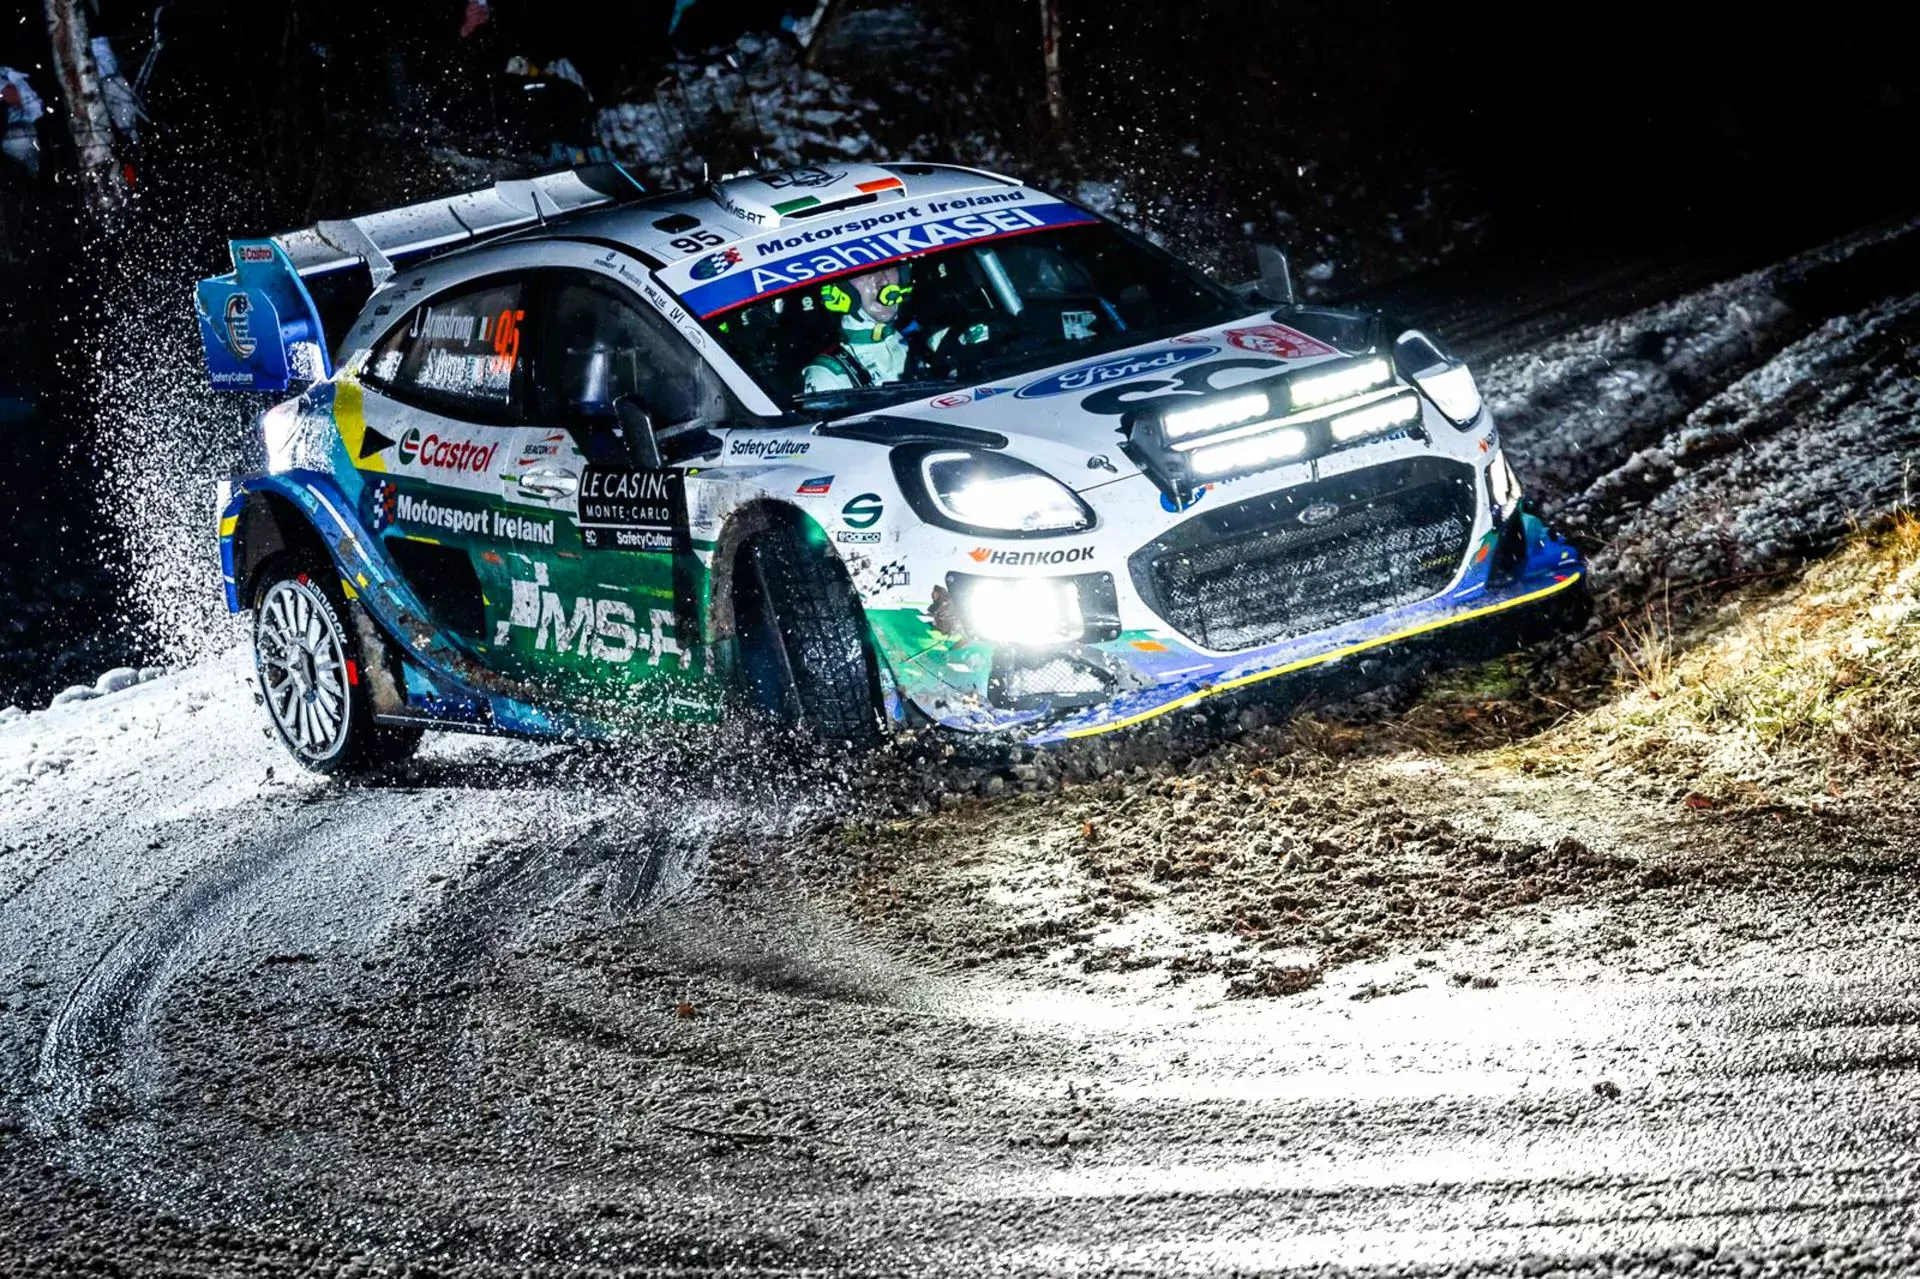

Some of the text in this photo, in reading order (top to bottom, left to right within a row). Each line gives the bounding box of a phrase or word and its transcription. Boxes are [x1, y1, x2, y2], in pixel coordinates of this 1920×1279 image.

[726, 205, 766, 225] MS-RT
[756, 190, 1024, 256] Motorsport Ireland
[670, 231, 725, 254] 95
[752, 208, 1046, 293] AsahiKASEI
[409, 307, 421, 338] J
[421, 307, 475, 348] Armstrong
[1058, 352, 1187, 390] Ford
[420, 434, 500, 472] Castrol
[730, 439, 810, 458] SafetyCulture
[581, 471, 600, 497] LE
[397, 494, 554, 545] Motorsport Ireland
[616, 531, 673, 549] SafetyCultur
[838, 533, 880, 542] sparco
